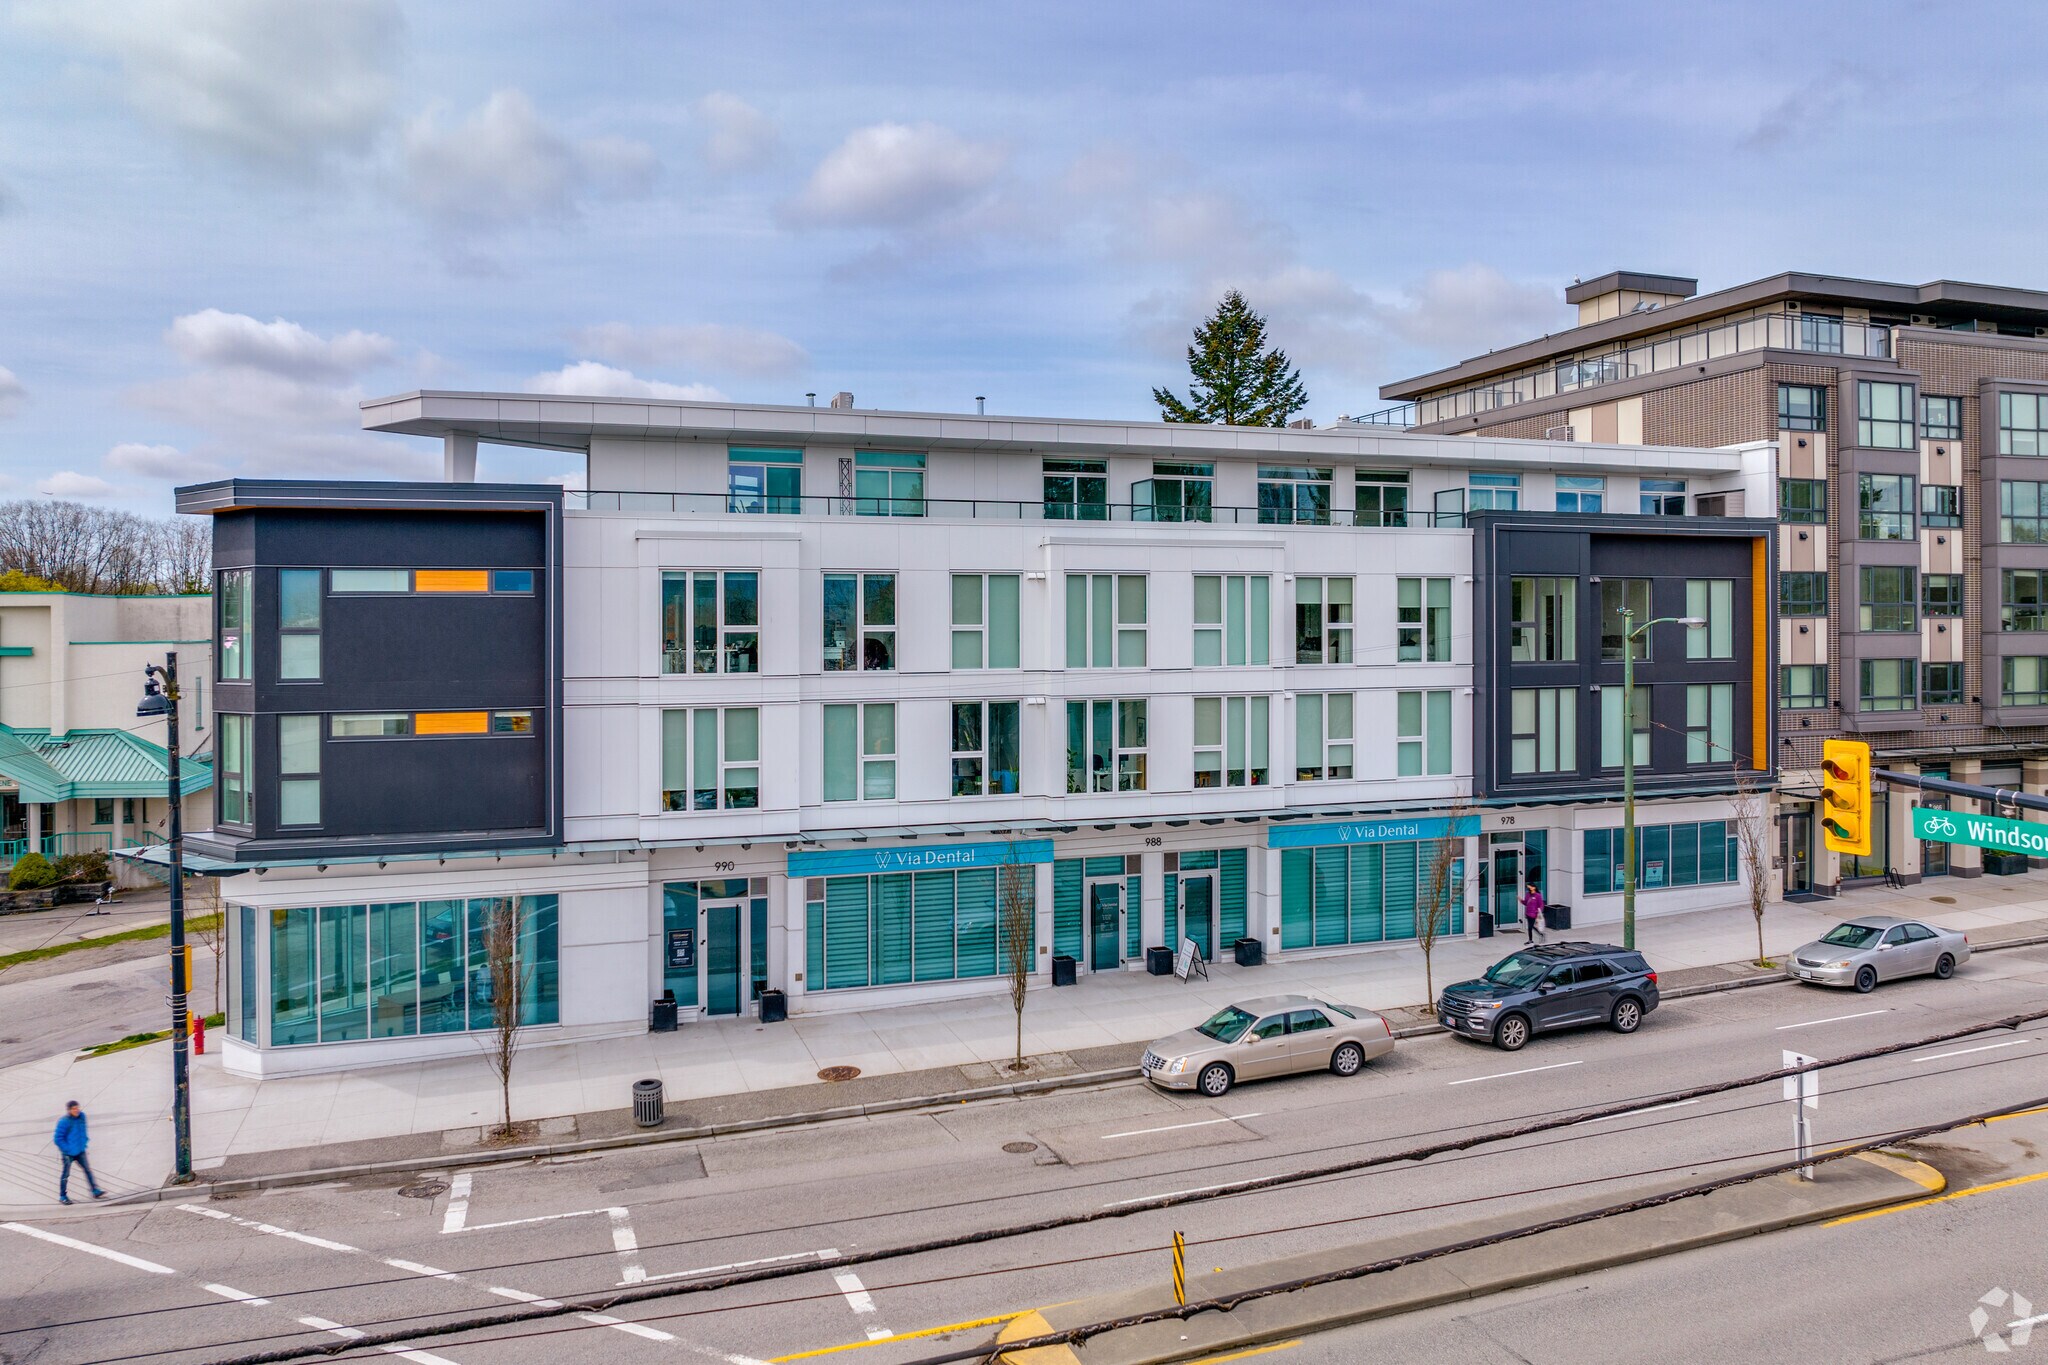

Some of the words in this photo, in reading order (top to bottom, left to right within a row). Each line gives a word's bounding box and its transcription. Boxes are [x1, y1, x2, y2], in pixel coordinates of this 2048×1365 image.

[1501, 816, 1515, 825] 978
[1355, 826, 1375, 838] Via
[1378, 823, 1418, 837] Dental
[1145, 836, 1162, 847] 988
[896, 851, 920, 866] Via
[925, 849, 975, 865] Dental
[714, 861, 735, 871] 990
